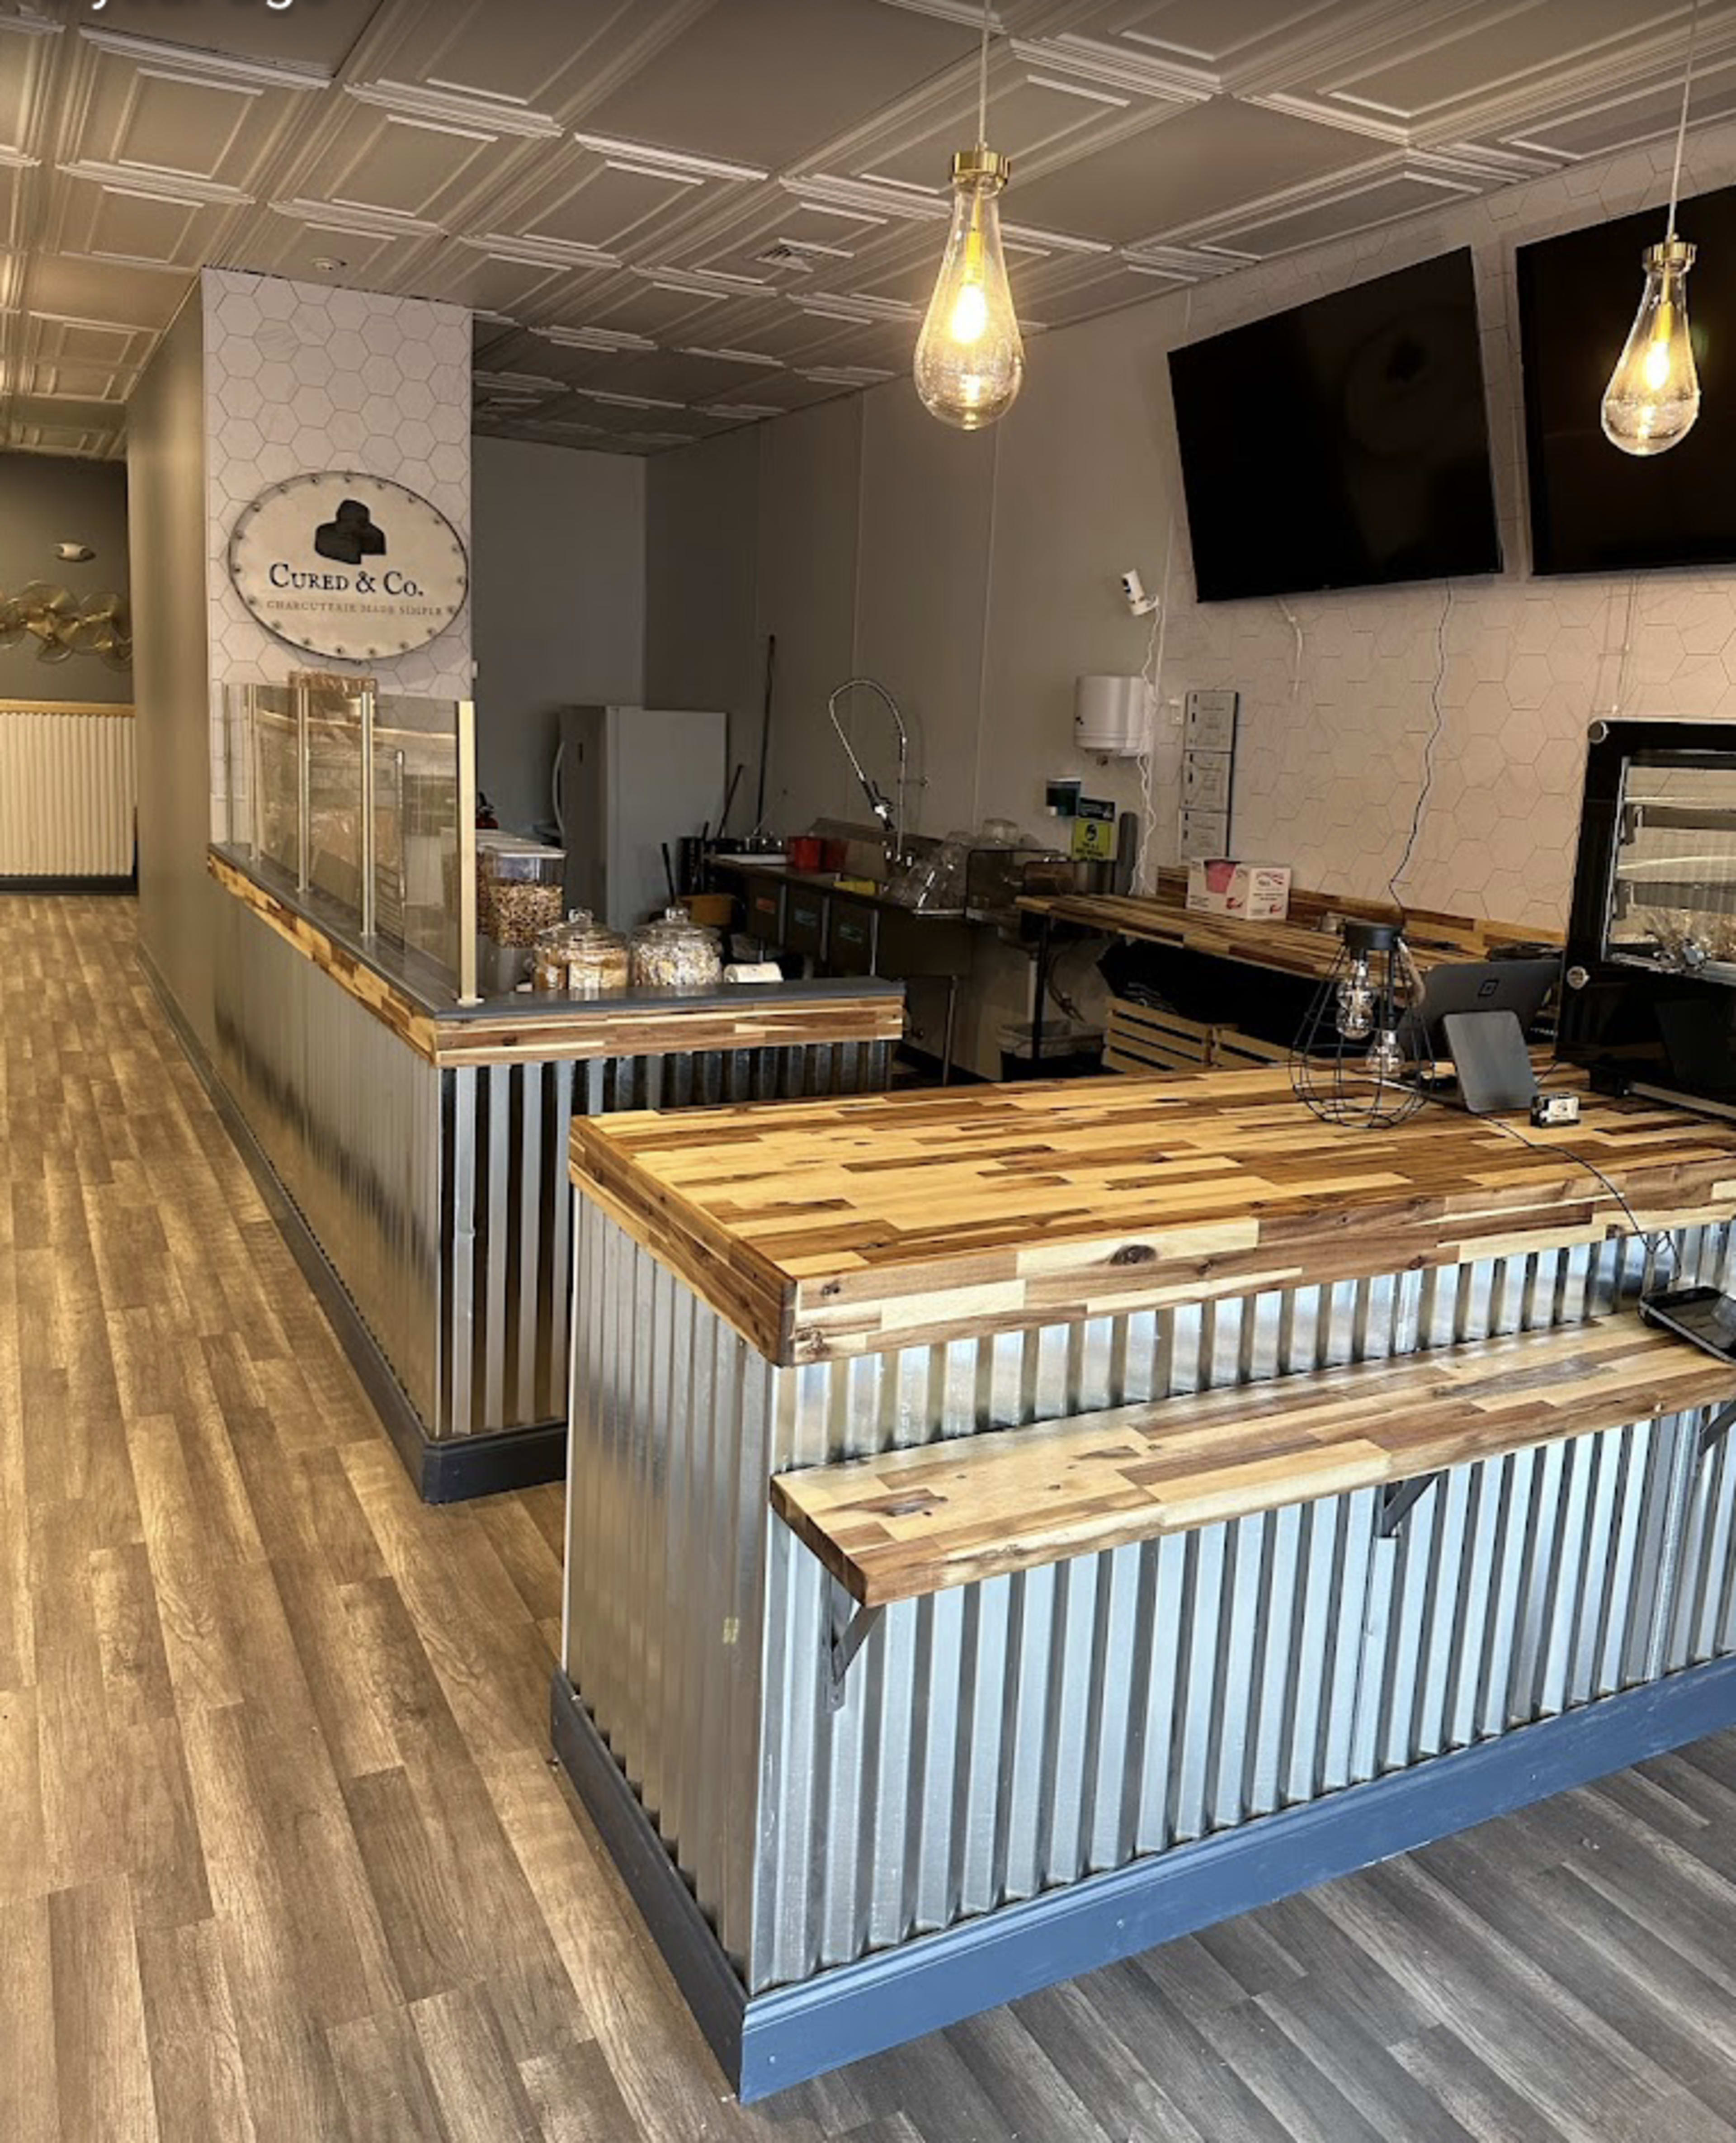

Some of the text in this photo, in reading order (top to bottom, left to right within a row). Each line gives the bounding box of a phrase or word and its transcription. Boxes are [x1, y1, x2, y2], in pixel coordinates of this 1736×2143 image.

[356, 570, 376, 593] &
[266, 600, 442, 616] CHARCUTERIE MADE SIMPLE
